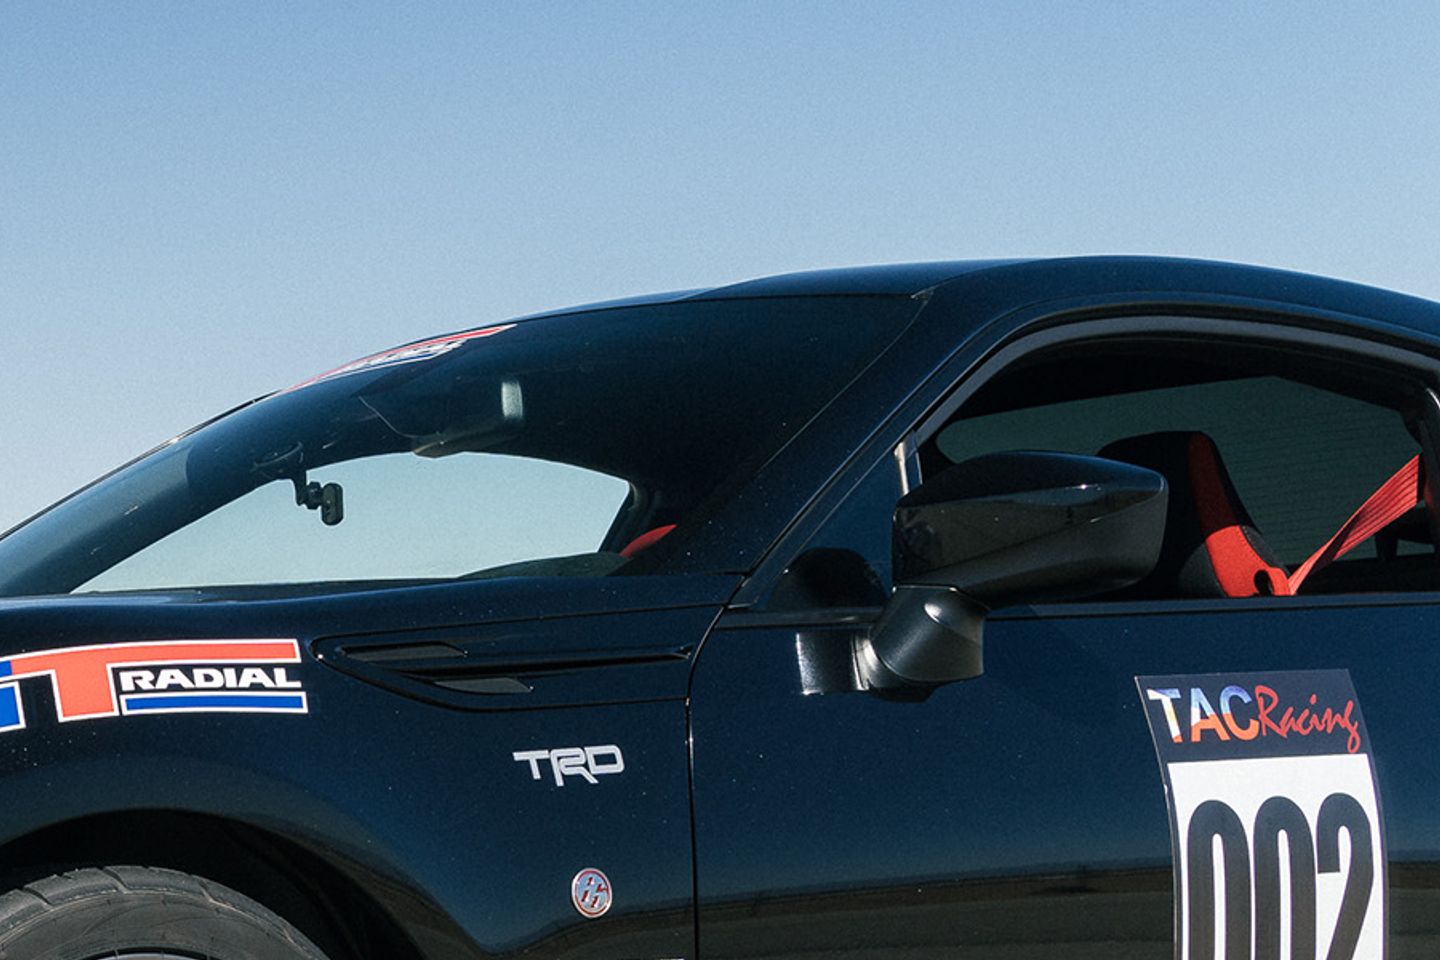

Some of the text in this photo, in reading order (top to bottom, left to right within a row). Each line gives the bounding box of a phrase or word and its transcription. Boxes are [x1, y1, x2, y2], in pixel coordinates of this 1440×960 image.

[119, 667, 302, 691] RADIAL
[1146, 684, 1361, 754] TAC Racing
[512, 744, 625, 787] TRD
